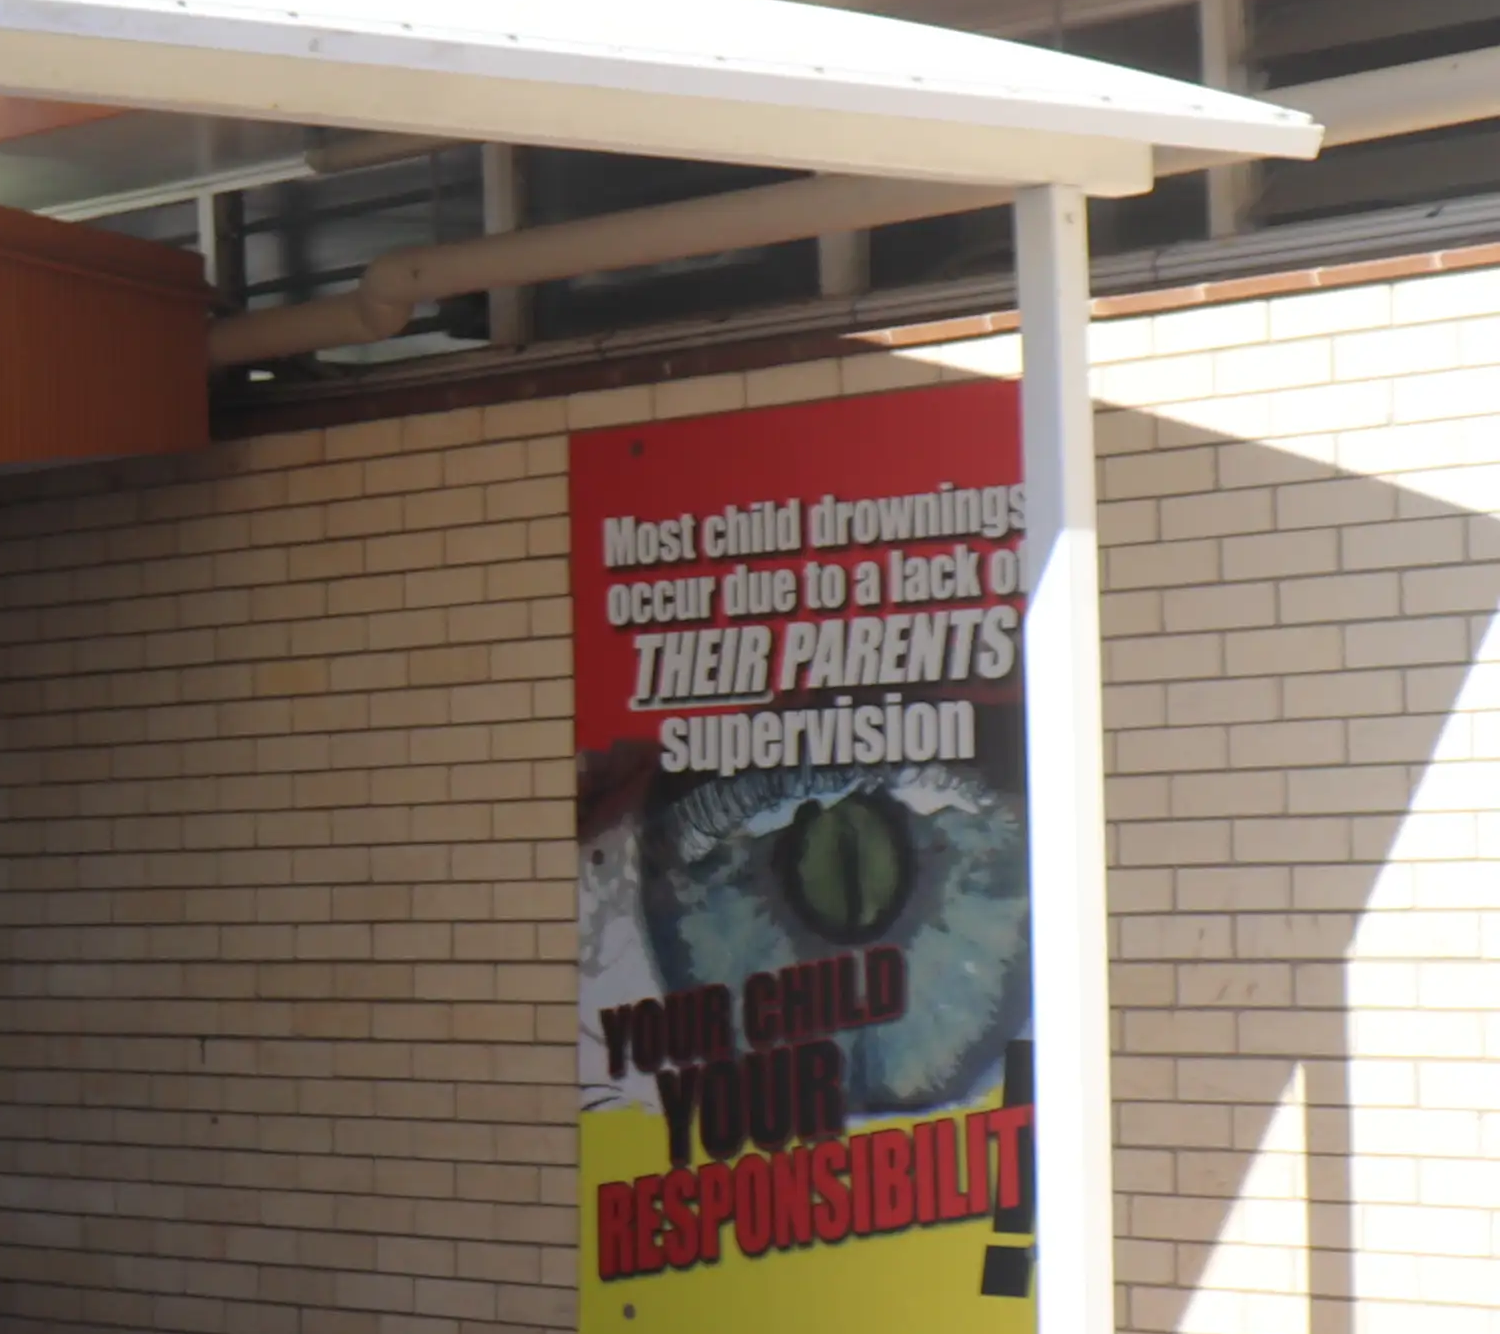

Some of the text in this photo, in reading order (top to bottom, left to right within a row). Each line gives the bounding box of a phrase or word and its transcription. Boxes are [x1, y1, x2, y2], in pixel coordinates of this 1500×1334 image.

[603, 481, 1026, 567] Most child drownings
[607, 575, 716, 626] occur
[722, 564, 798, 617] due
[803, 562, 847, 610] to
[853, 561, 882, 606] a
[888, 543, 982, 603] lack
[631, 604, 1019, 710] THEIR PARENTS
[659, 693, 976, 778] supervision
[599, 946, 909, 1080] YOUR CHILD
[654, 1038, 849, 1169] YOUR
[597, 1104, 1034, 1282] RESPONSIBILIT
